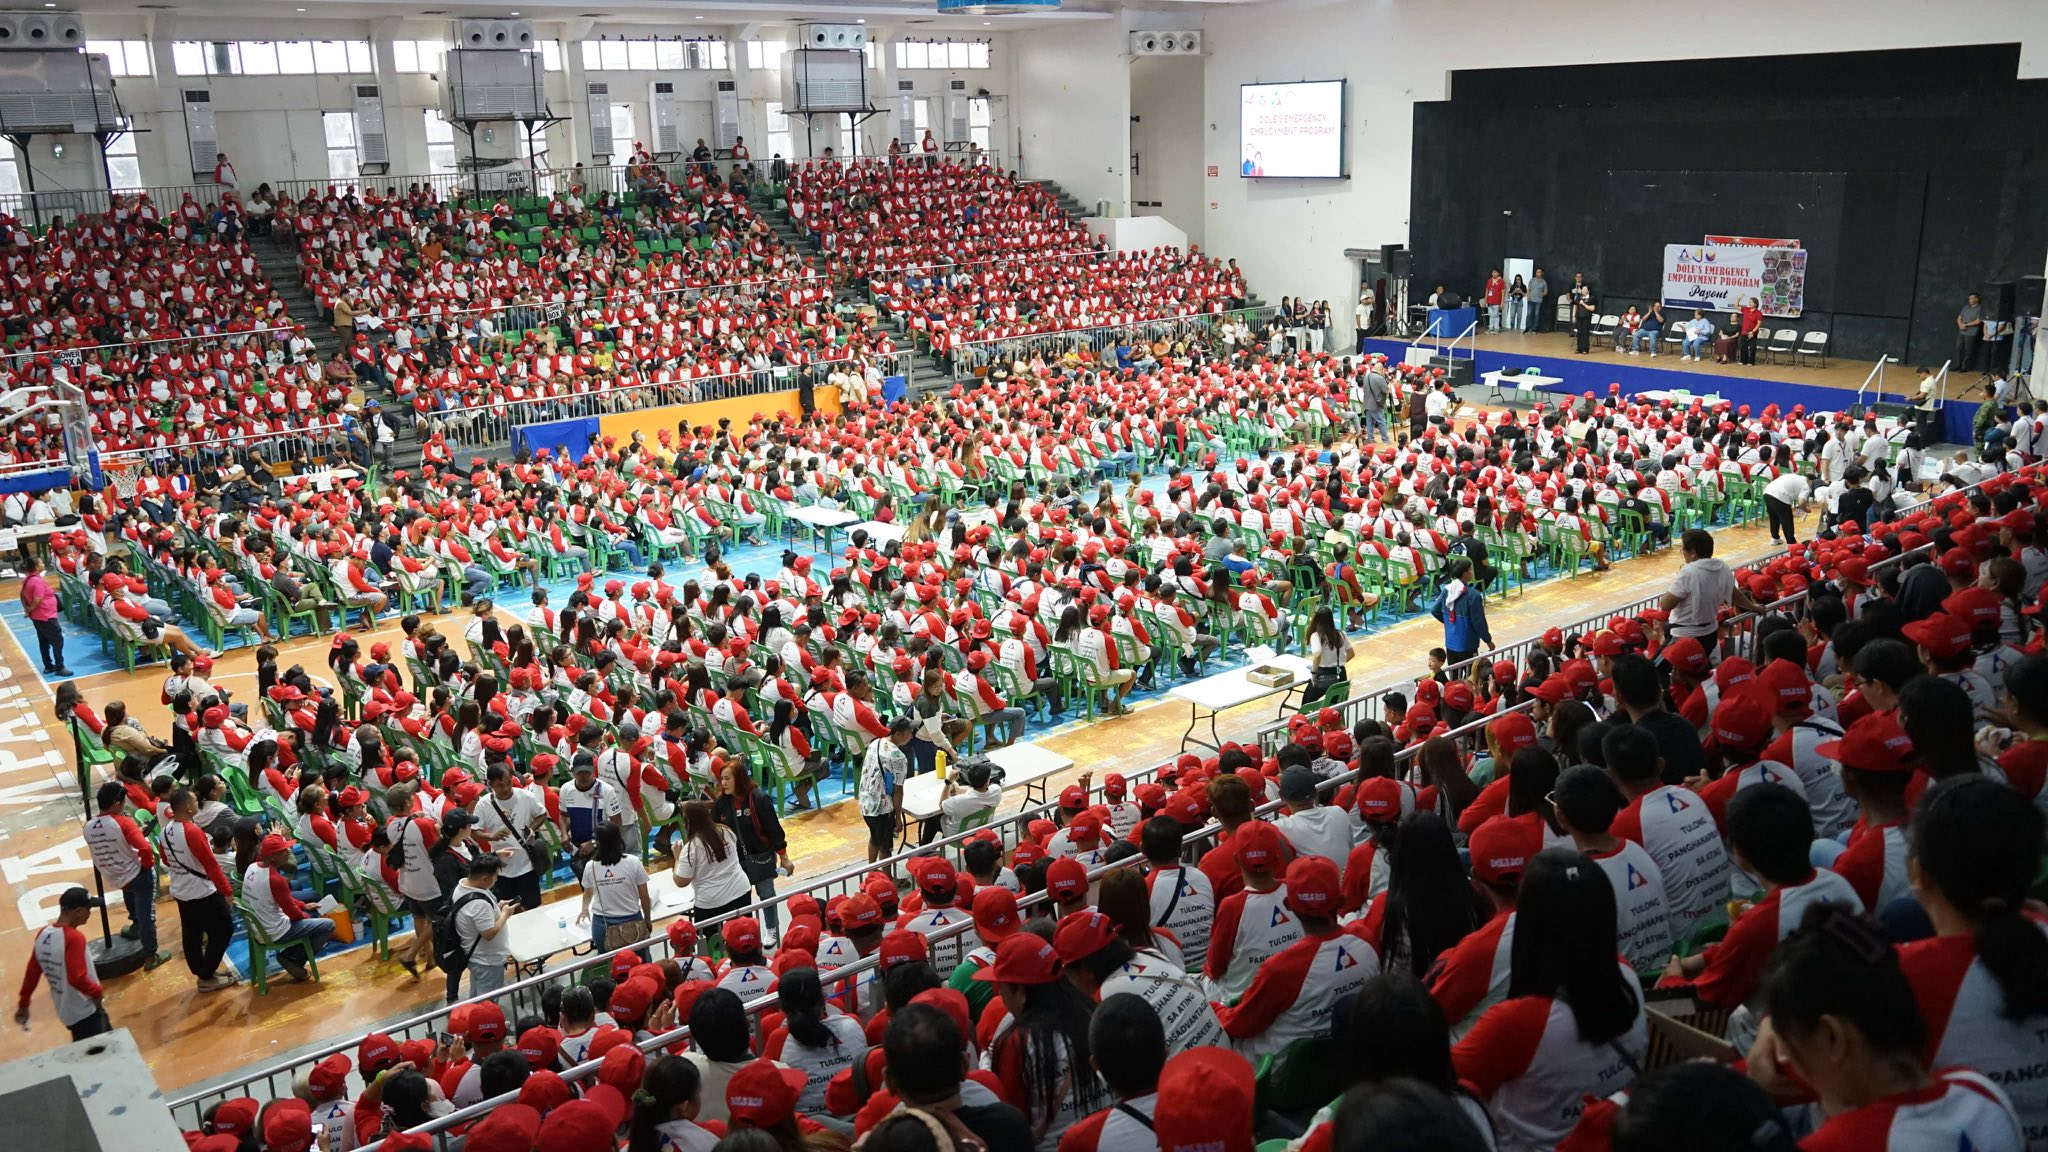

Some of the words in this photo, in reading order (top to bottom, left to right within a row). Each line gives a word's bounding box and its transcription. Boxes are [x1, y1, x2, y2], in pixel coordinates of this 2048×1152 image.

[1284, 113, 1327, 123] EMERGENCY
[1250, 127, 1298, 136] EMPLOYMENT
[1300, 126, 1335, 135] PROGRAM
[1676, 263, 1702, 275] DOLE'S
[1705, 266, 1750, 277] EMERGENCY
[1668, 273, 1717, 285] EMPLOYMENT
[1720, 276, 1760, 288] PROGRAM
[1688, 284, 1728, 301] Payout
[546, 303, 563, 313] LOWER
[547, 311, 560, 319] BOX
[61, 351, 80, 359] OWER
[1680, 817, 1707, 834] TULONG
[1179, 903, 1206, 915] TULONG
[1630, 897, 1661, 916] TULONG
[1182, 931, 1191, 939] SA
[1268, 932, 1298, 948] TULONG
[739, 987, 765, 997] TULONG
[1143, 971, 1169, 999] TULOG
[1334, 977, 1366, 996] TULONG
[1167, 1012, 1180, 1024] SA
[1178, 992, 1195, 1015] ATING
[1166, 1000, 1209, 1048] DISADVANTAGE
[818, 1054, 853, 1068] TULONG
[1987, 1063, 2048, 1086] PANG
